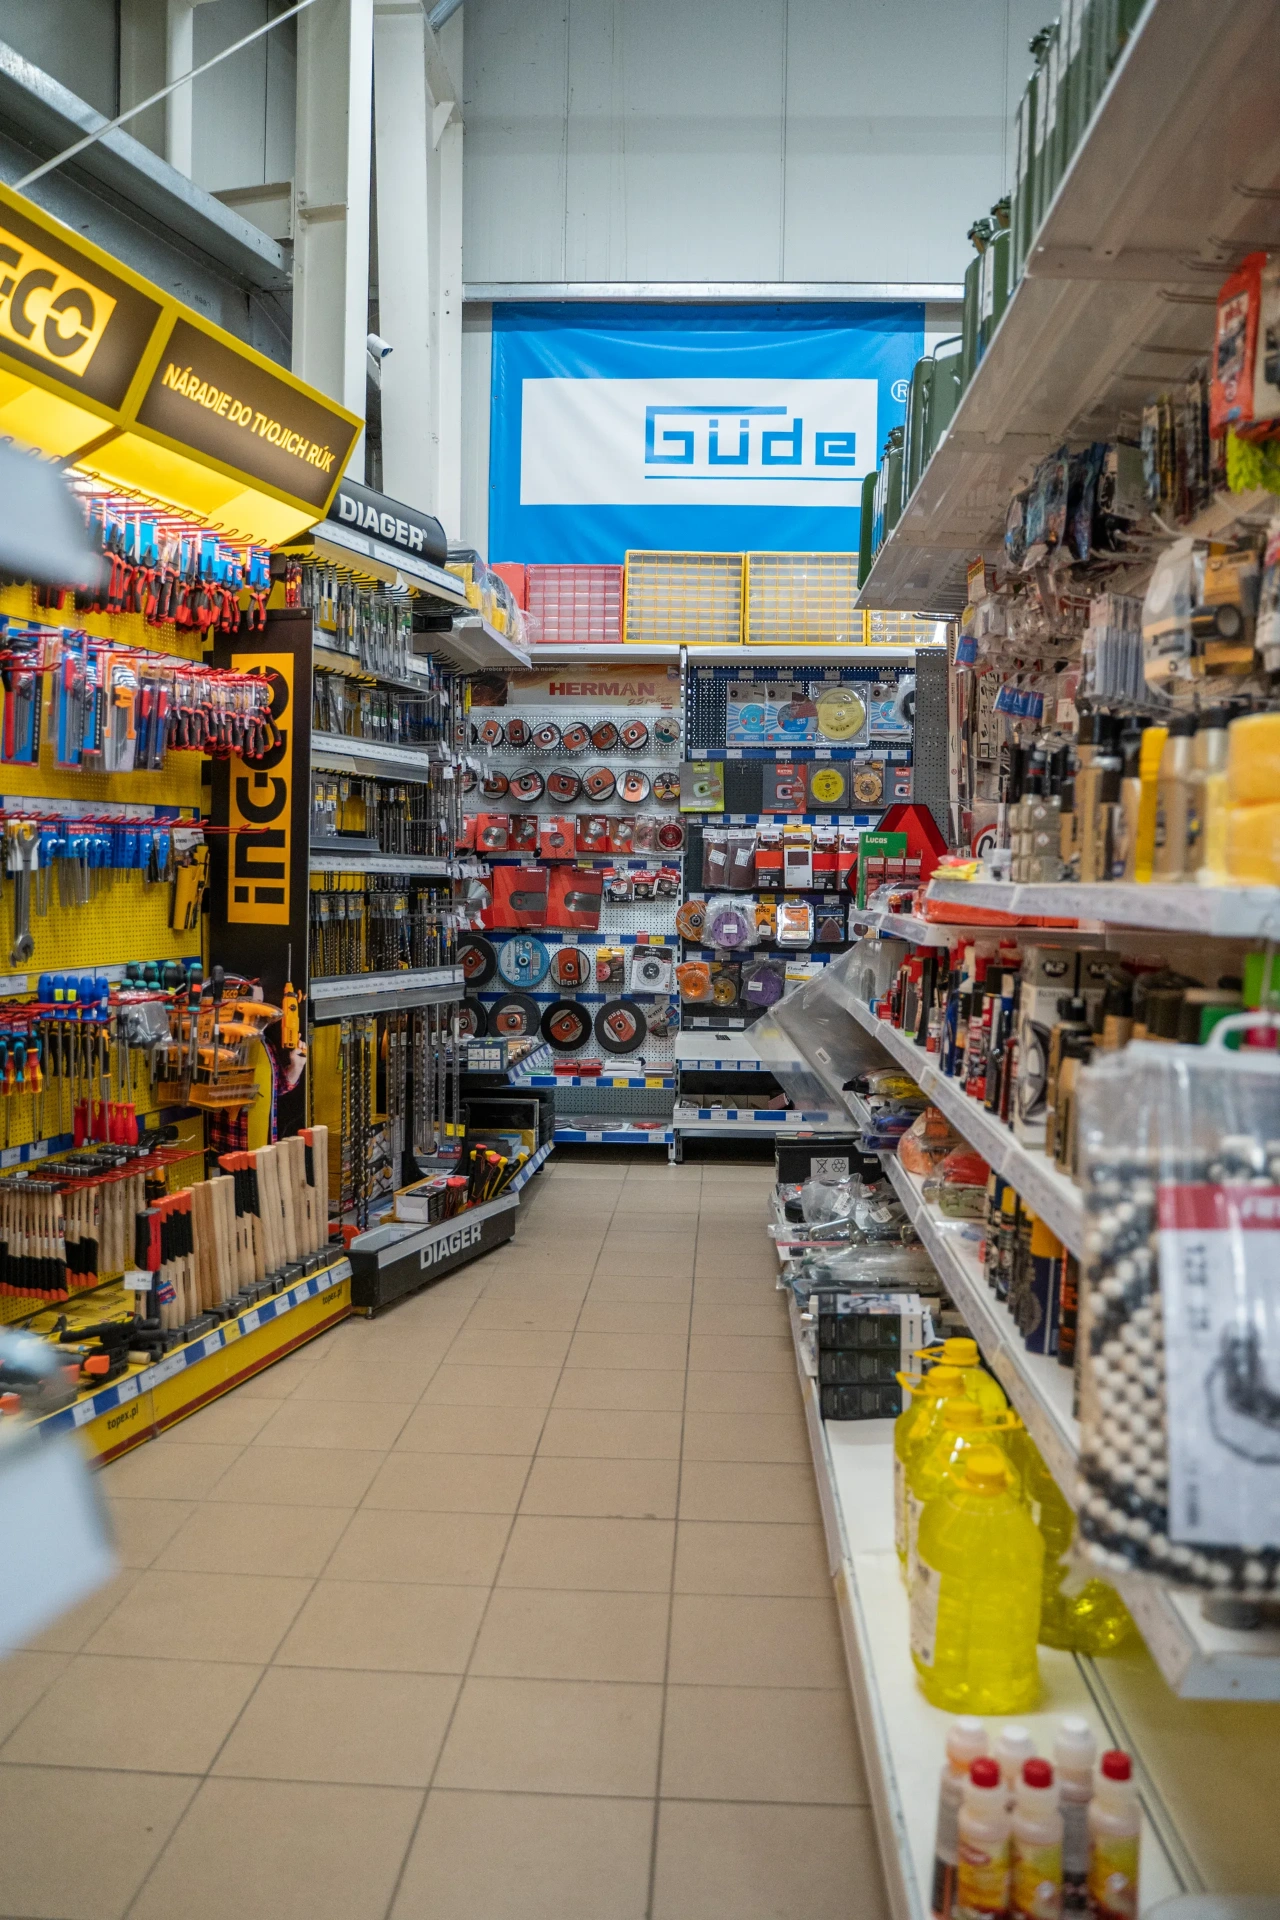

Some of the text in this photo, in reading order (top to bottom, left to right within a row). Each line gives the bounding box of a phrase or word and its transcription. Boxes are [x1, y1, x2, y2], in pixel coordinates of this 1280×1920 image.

[161, 362, 336, 474] NÁRADIE DO TVOJICH RÚK
[645, 406, 856, 466] Güde
[338, 493, 424, 552] DIAGER
[549, 682, 655, 696] HERMAN
[865, 835, 888, 845] Lucas
[420, 1226, 482, 1270] DIAGER
[106, 1403, 139, 1431] topex.pl
